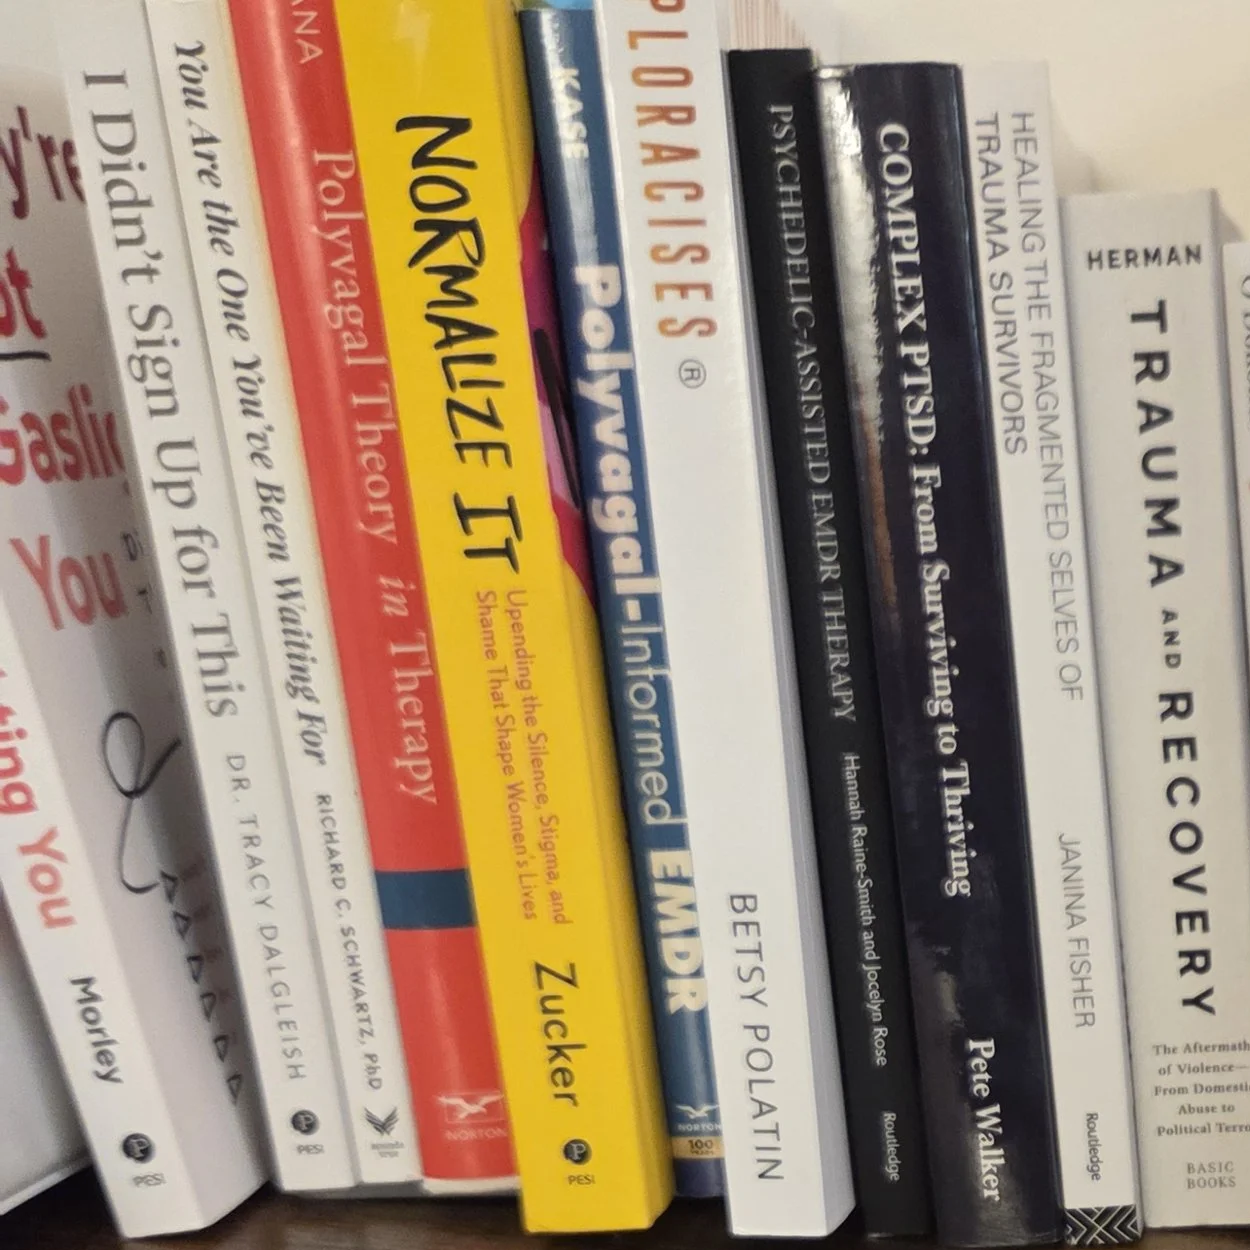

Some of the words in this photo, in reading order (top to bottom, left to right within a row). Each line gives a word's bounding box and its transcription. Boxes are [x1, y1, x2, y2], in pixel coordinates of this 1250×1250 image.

[83, 70, 127, 88] I
[174, 41, 209, 110] You
[550, 66, 590, 159] KASE
[94, 109, 164, 285] Didn't
[187, 118, 222, 189] Are
[975, 112, 1010, 264] TRAUMA
[1012, 111, 1047, 260] HEALING
[202, 199, 239, 257] the
[311, 148, 386, 369] Polyvagal
[879, 122, 926, 342] COMPLEX
[1086, 243, 1202, 272] HERMAN
[215, 267, 250, 342] One
[395, 114, 515, 470] NORMALIZE
[770, 103, 833, 484] PSYCHEDELIC-ASSISTED
[1022, 259, 1052, 322] THE
[126, 301, 182, 420] Sign
[899, 347, 937, 457] PTSD:
[989, 271, 1028, 457] SURVIVORS
[232, 353, 275, 471] You've
[1029, 332, 1070, 542] FRAGMENTED
[1129, 299, 1186, 589] TRAUMA
[152, 437, 202, 511] Up
[350, 385, 401, 546] Theory
[909, 463, 943, 555] From
[172, 526, 219, 599] for
[253, 477, 290, 564] Been
[452, 491, 525, 575] IT
[811, 486, 841, 582] EMDR
[11, 535, 129, 630] You
[377, 574, 414, 621] in
[475, 590, 499, 662] Shame
[1048, 550, 1080, 655] SELVES
[191, 610, 241, 719] This
[274, 574, 320, 705] Waiting
[504, 588, 537, 692] Upending
[575, 264, 689, 826] Polyvagal-Informed
[650, 848, 709, 1015] EMDR
[821, 583, 857, 722] THERAPY
[921, 562, 960, 721] Surviving
[1056, 665, 1084, 702] OF
[1159, 607, 1182, 670] AND
[388, 636, 440, 806] Therapy
[486, 663, 509, 710] That
[521, 694, 539, 728] the
[226, 753, 251, 804] DR.
[299, 701, 328, 768] For
[494, 713, 517, 778] Shape
[527, 731, 550, 811] Silence,
[936, 723, 959, 755] to
[505, 780, 529, 872] Women's
[843, 752, 862, 822] Hannah
[940, 762, 974, 898] Thriving
[17, 826, 77, 929] You
[237, 814, 274, 911] TRACY
[316, 792, 346, 896] RICHARD
[538, 814, 560, 886] Stigma,
[851, 824, 875, 926] Raine-Smith
[1057, 831, 1086, 932] JANINA
[1158, 690, 1217, 1016] RECOVERY
[334, 896, 353, 921] C.
[518, 873, 538, 921] Lives
[548, 889, 573, 926] and
[341, 924, 377, 1048] SCHWARTZ,
[729, 894, 769, 1008] BETSY
[860, 929, 876, 962] and
[1067, 936, 1097, 1030] FISHER
[71, 976, 124, 1086] Morley
[257, 921, 308, 1082] DALGLEISH
[534, 960, 587, 1108] Zucker
[862, 964, 883, 1025] Jocelyn
[364, 1052, 384, 1092] PhD
[873, 1026, 888, 1067] Rose
[965, 1036, 997, 1099] Pete
[1152, 1042, 1179, 1057] The
[1182, 1039, 1250, 1055] Aftermath
[1153, 1083, 1186, 1098] From
[1157, 1062, 1172, 1077] of
[743, 1024, 785, 1182] POLATIN
[882, 1111, 901, 1182] Routledge
[1084, 1111, 1101, 1182] Routledge
[1156, 1122, 1212, 1138] Political
[1177, 1102, 1215, 1116] Abuse
[1219, 1101, 1236, 1115] to
[972, 1102, 1007, 1203] Walker
[1186, 1160, 1235, 1176] BASIC
[1186, 1176, 1237, 1190] BOOKS
